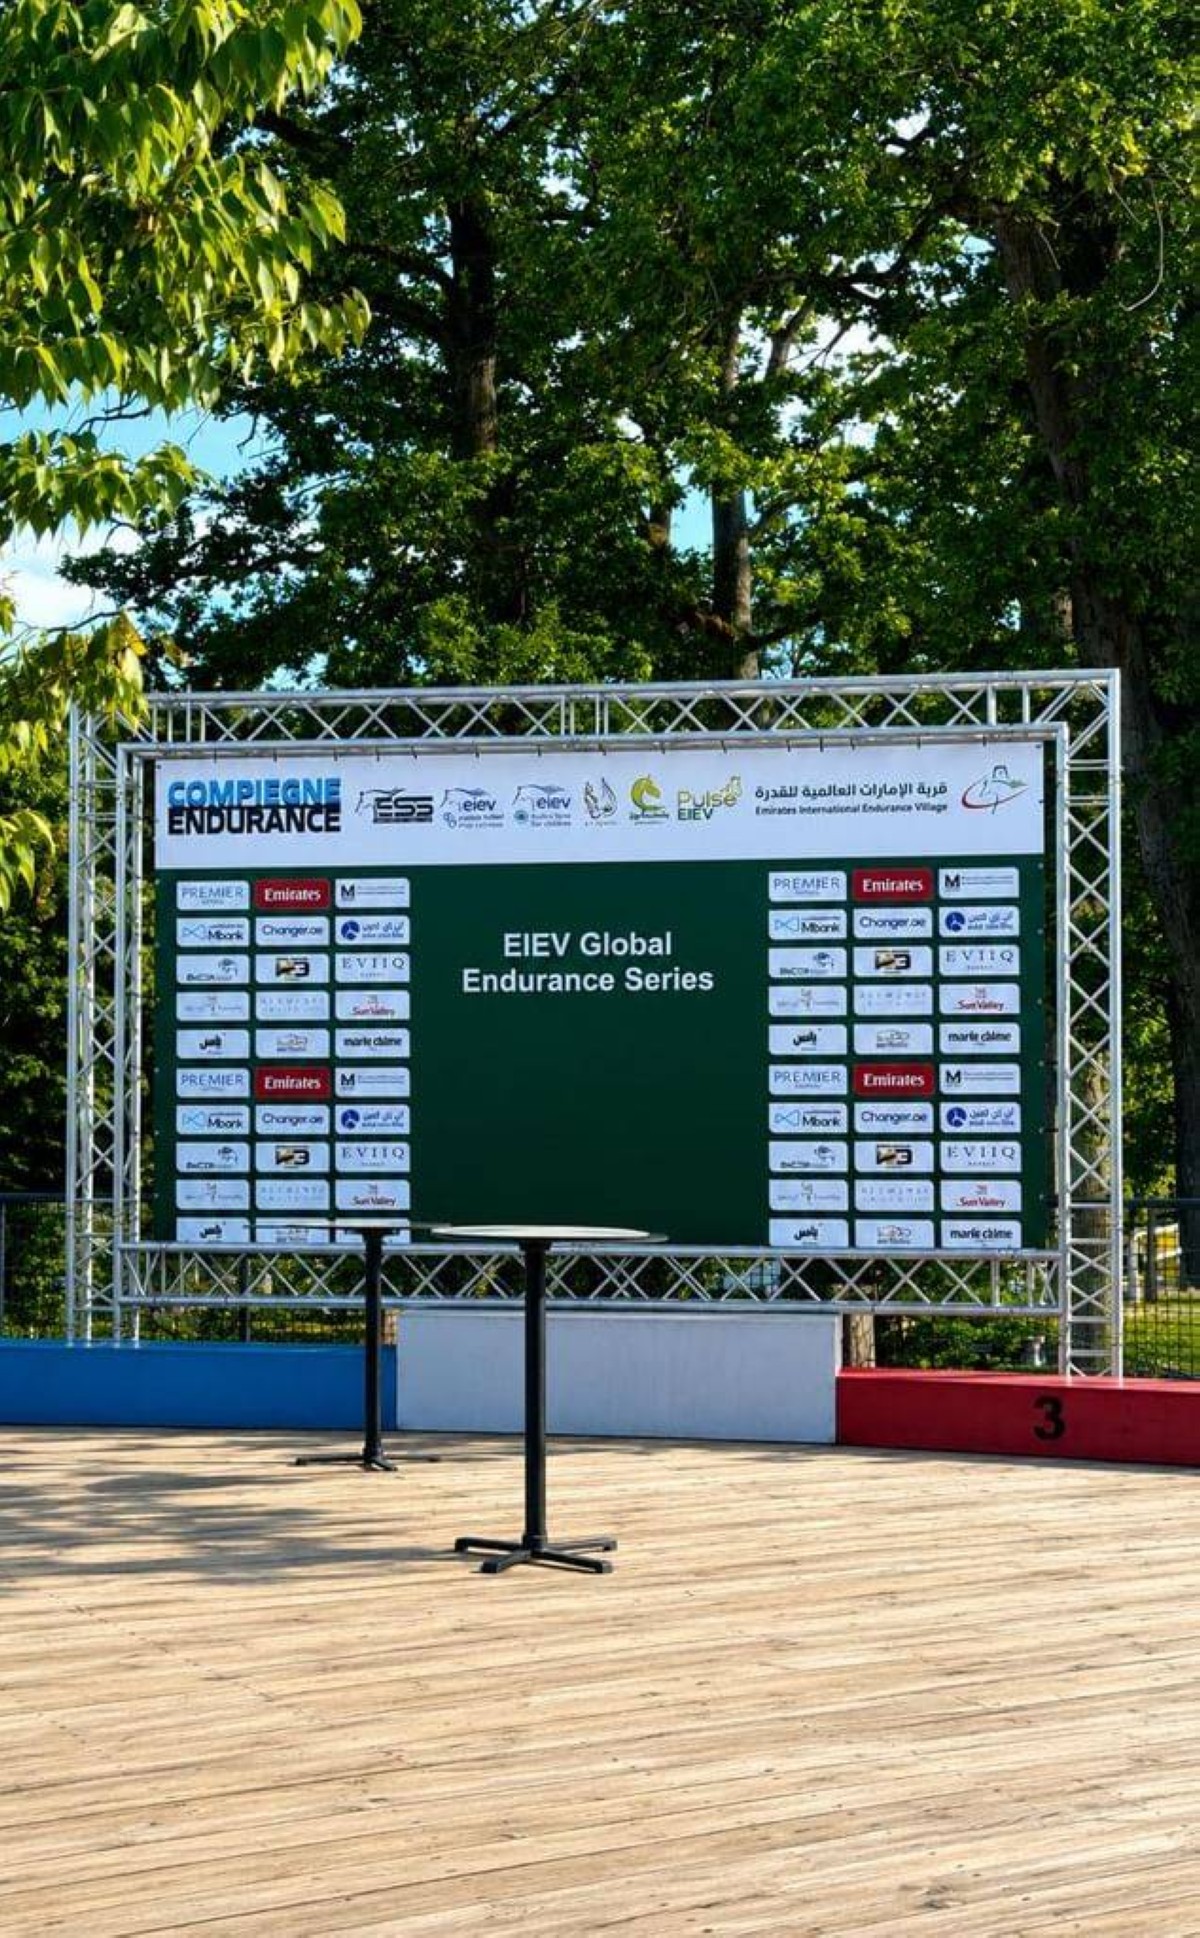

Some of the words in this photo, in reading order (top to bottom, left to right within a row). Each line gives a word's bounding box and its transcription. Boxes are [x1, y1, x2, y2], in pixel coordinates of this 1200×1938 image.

[168, 779, 341, 806] COMPIEGNE
[755, 786, 797, 800] للقدرة
[802, 784, 856, 798] العالمية
[860, 783, 912, 797] الإمارات
[918, 783, 948, 796] قرية
[677, 791, 737, 807] Pulse
[677, 808, 713, 820] EIEV
[755, 806, 796, 815] Emirates
[799, 805, 860, 814] International
[863, 804, 912, 813] Endurance
[915, 802, 948, 813] Village
[168, 805, 341, 835] ENDURANCE
[773, 877, 840, 890] PREMIER
[863, 878, 922, 892] Emirates
[181, 886, 244, 899] PREMIER
[264, 888, 321, 902] Emirates
[860, 916, 926, 929] Changer.ae
[262, 925, 323, 938] Changer.ae
[503, 932, 571, 957] EIEV
[580, 931, 672, 956] Global
[462, 968, 615, 993] Endurance
[624, 966, 714, 991] Series
[181, 1074, 244, 1085] PREMIER
[264, 1077, 321, 1090] Emirates
[774, 1071, 841, 1084] PREMIER
[863, 1073, 925, 1087] Emirates
[262, 1113, 324, 1126] Changer.ae
[861, 1111, 927, 1124] Changer.ae
[1032, 1395, 1066, 1441] 3
